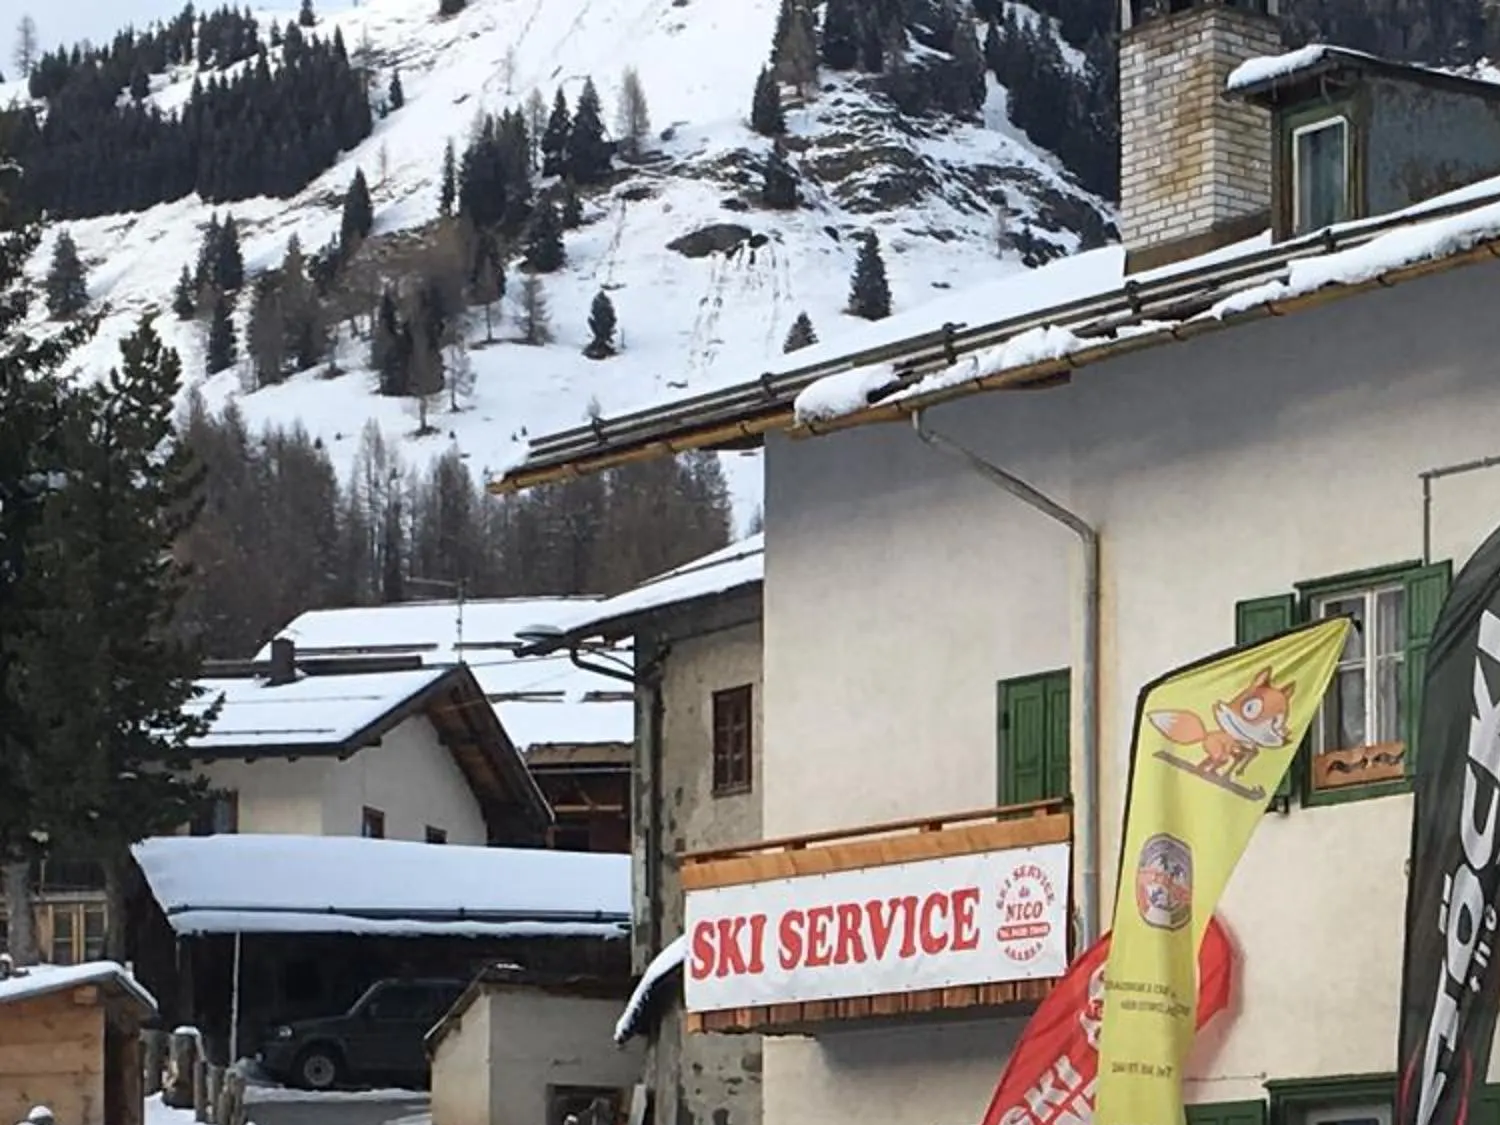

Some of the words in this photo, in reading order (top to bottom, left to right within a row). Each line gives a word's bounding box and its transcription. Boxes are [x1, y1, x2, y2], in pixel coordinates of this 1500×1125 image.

[690, 913, 768, 980] SKI
[778, 886, 980, 970] SERVICE
[1005, 901, 1043, 922] NICO
